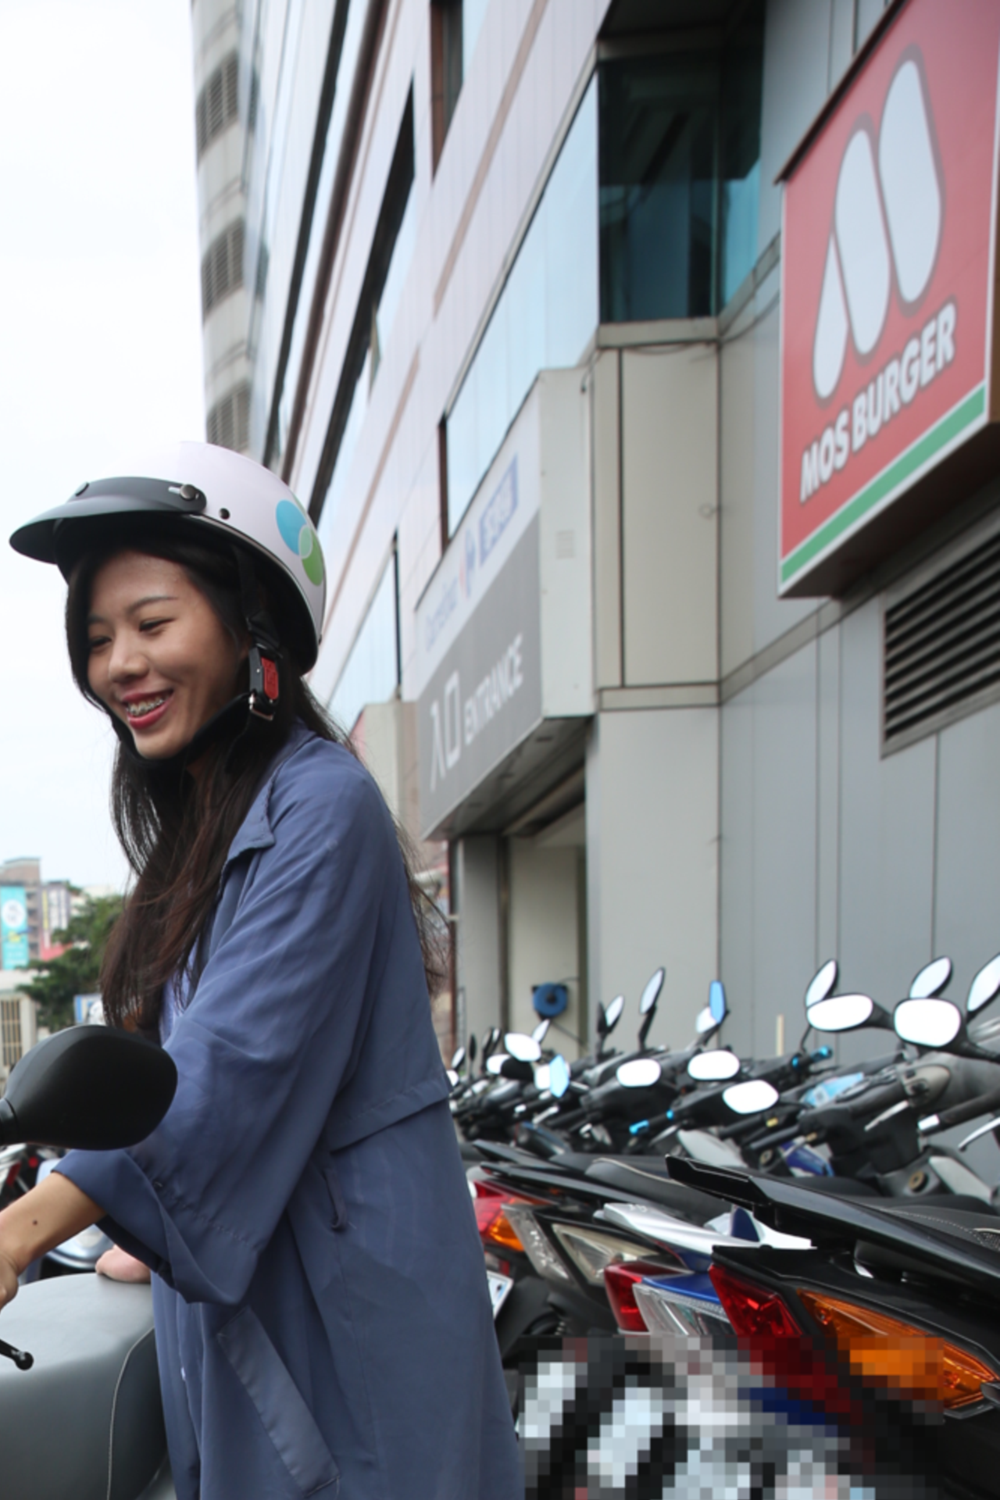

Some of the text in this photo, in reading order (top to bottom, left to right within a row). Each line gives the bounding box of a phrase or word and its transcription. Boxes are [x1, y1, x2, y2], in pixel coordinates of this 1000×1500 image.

[800, 302, 957, 504] MOS BURGER
[430, 669, 462, 794] 入口
[464, 632, 524, 746] ENTRANCE
